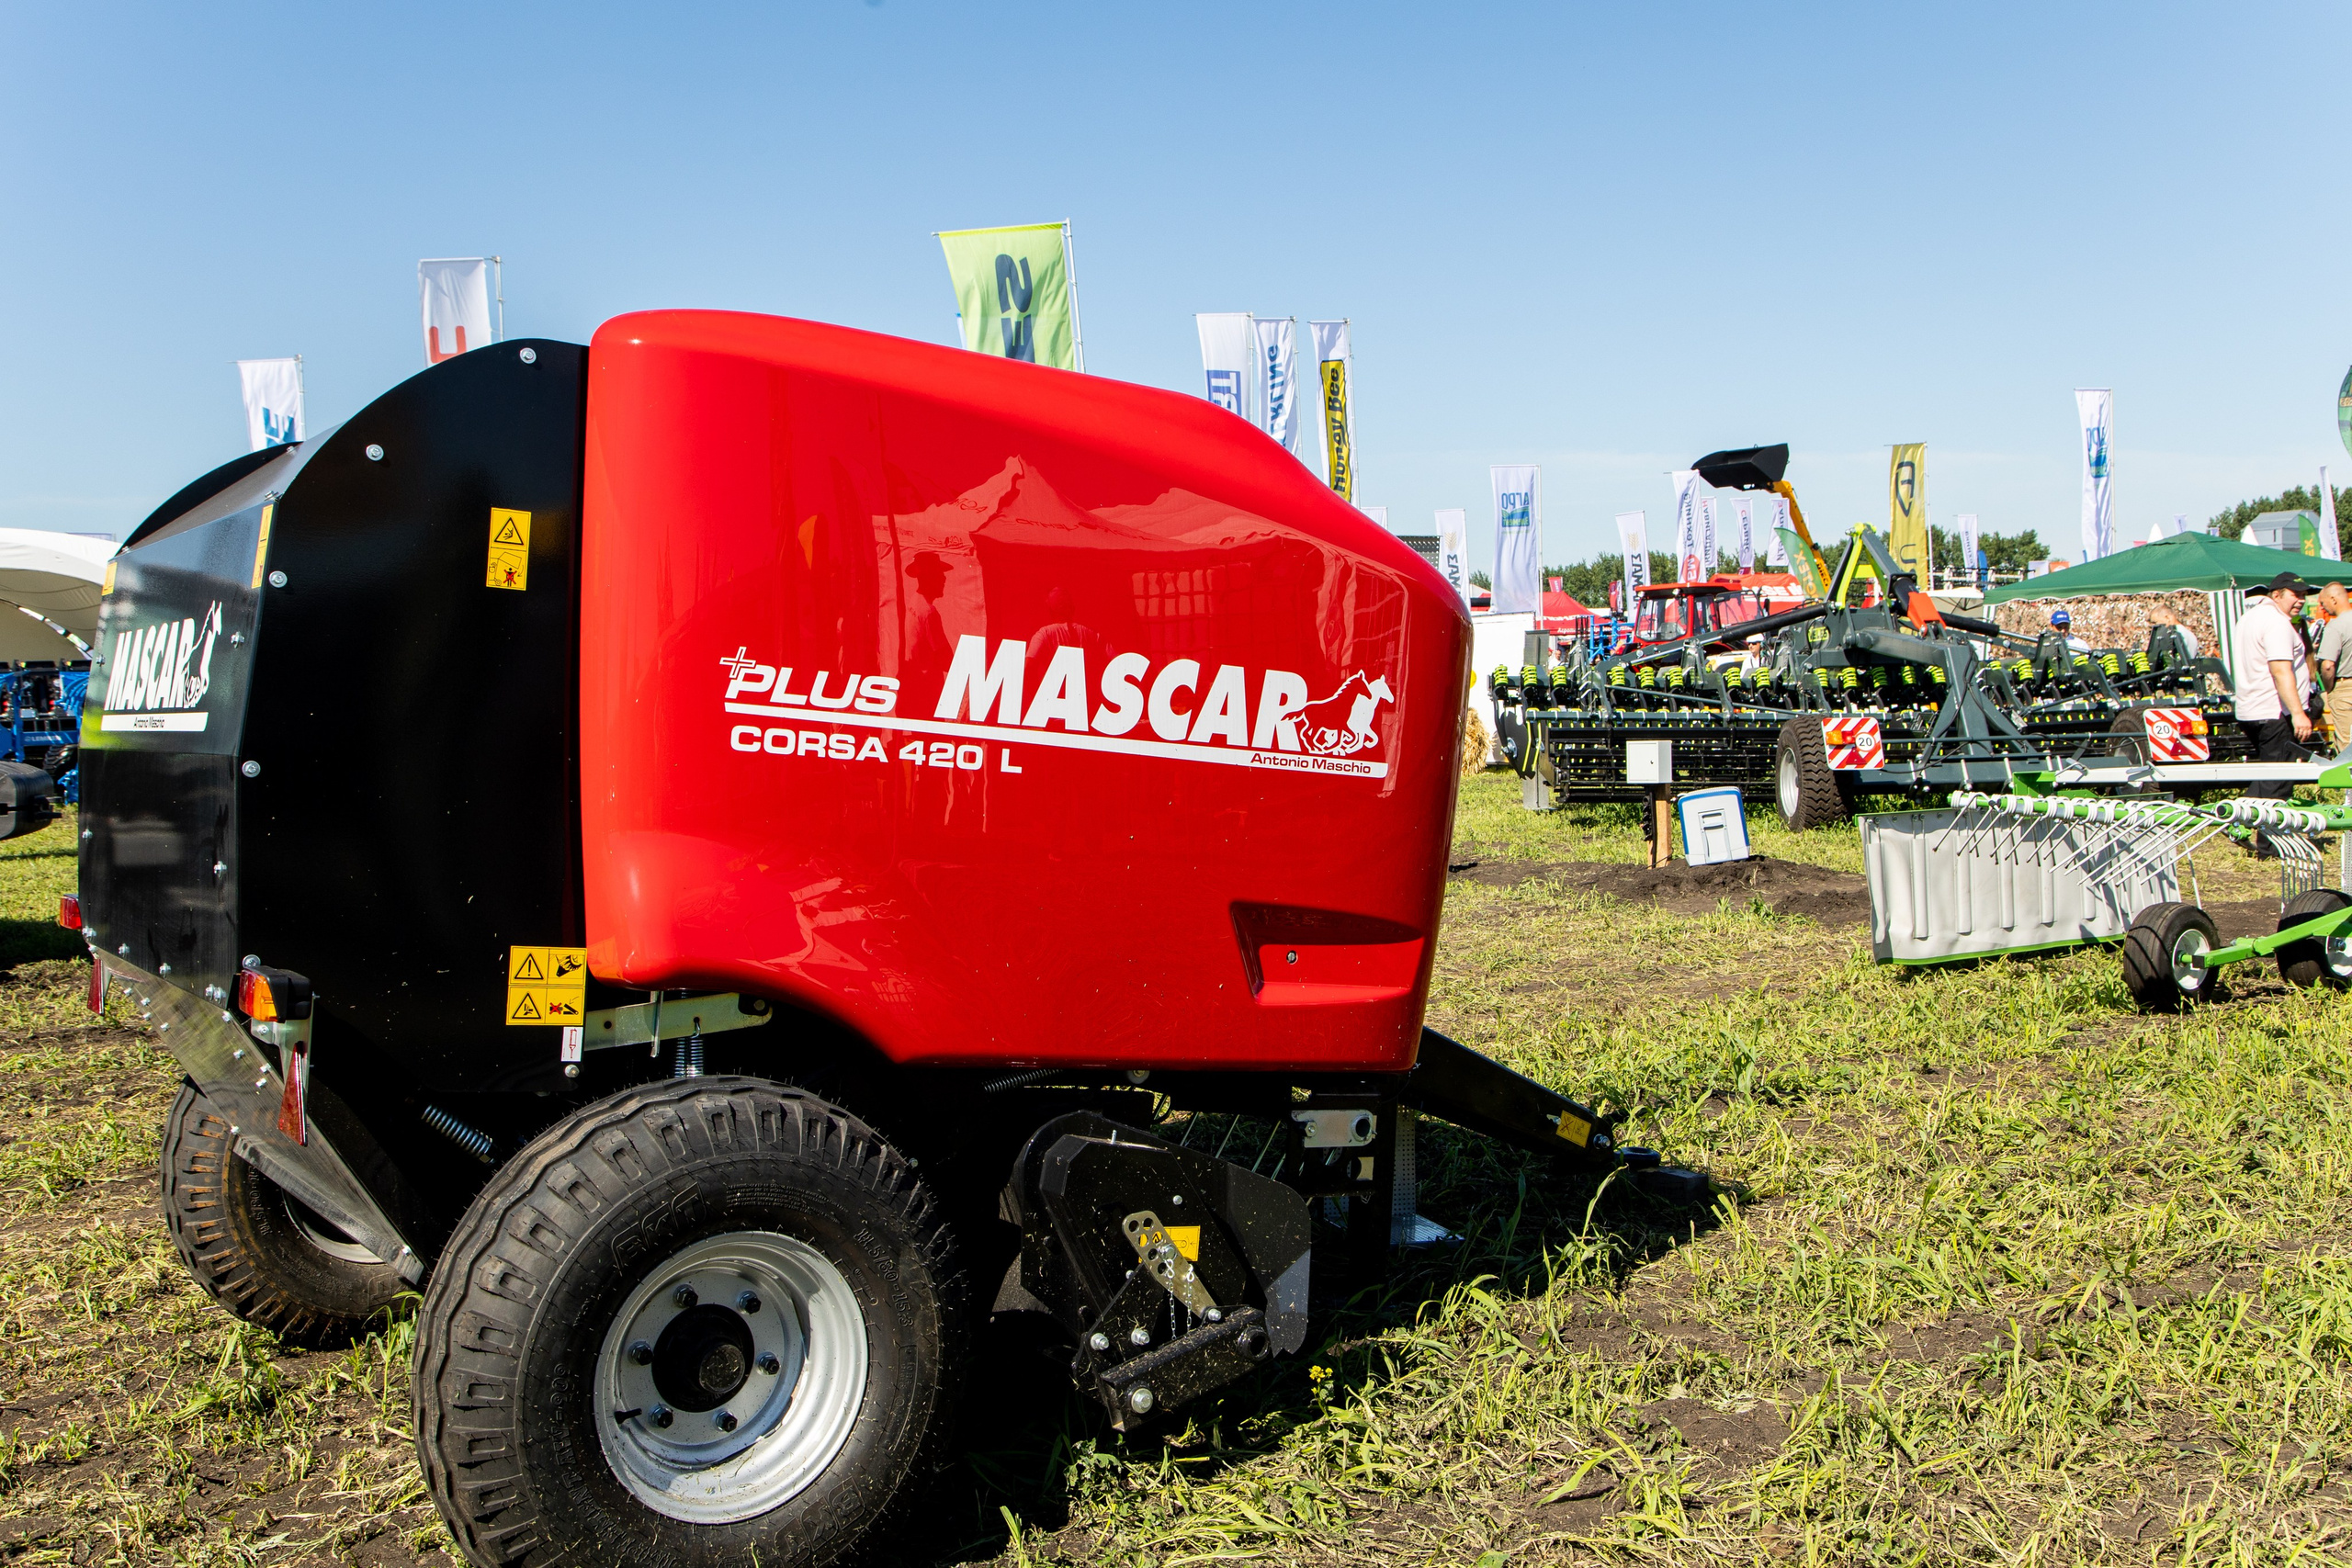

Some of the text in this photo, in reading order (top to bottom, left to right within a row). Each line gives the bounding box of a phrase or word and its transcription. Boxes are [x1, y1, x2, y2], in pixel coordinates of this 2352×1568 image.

[1328, 367, 1342, 413] Bee
[104, 617, 196, 711] MASCAR
[933, 635, 1308, 752] MASCAR
[729, 725, 1023, 773] CORSA 420 L
[1858, 737, 1873, 748] 20
[2155, 725, 2170, 735] 20
[1250, 752, 1371, 775] Antonio Maschio
